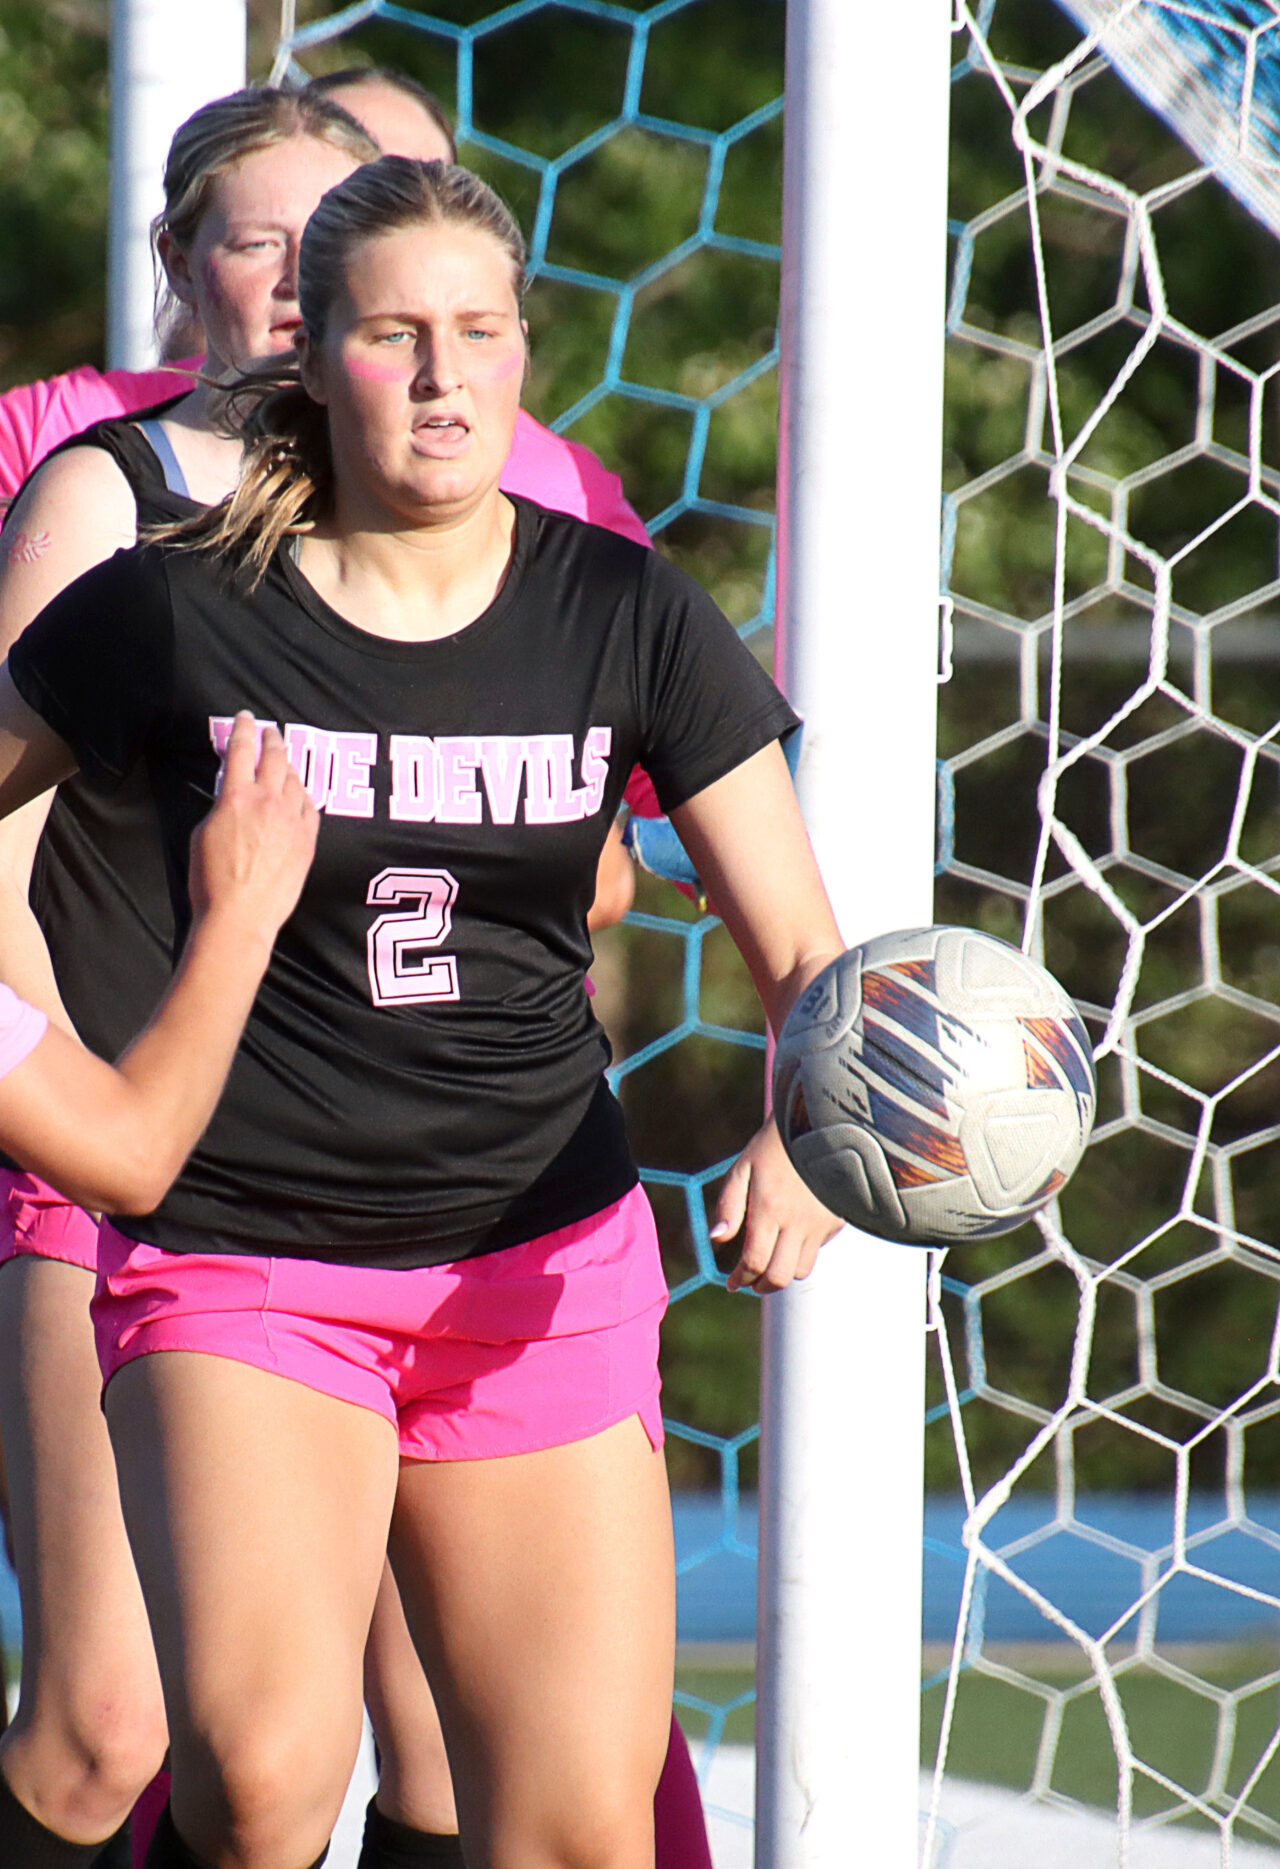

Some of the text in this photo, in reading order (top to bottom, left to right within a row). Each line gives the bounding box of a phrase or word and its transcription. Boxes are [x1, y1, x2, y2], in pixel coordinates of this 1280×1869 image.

[209, 716, 612, 824] UE DEVILS
[366, 867, 460, 1007] 2
